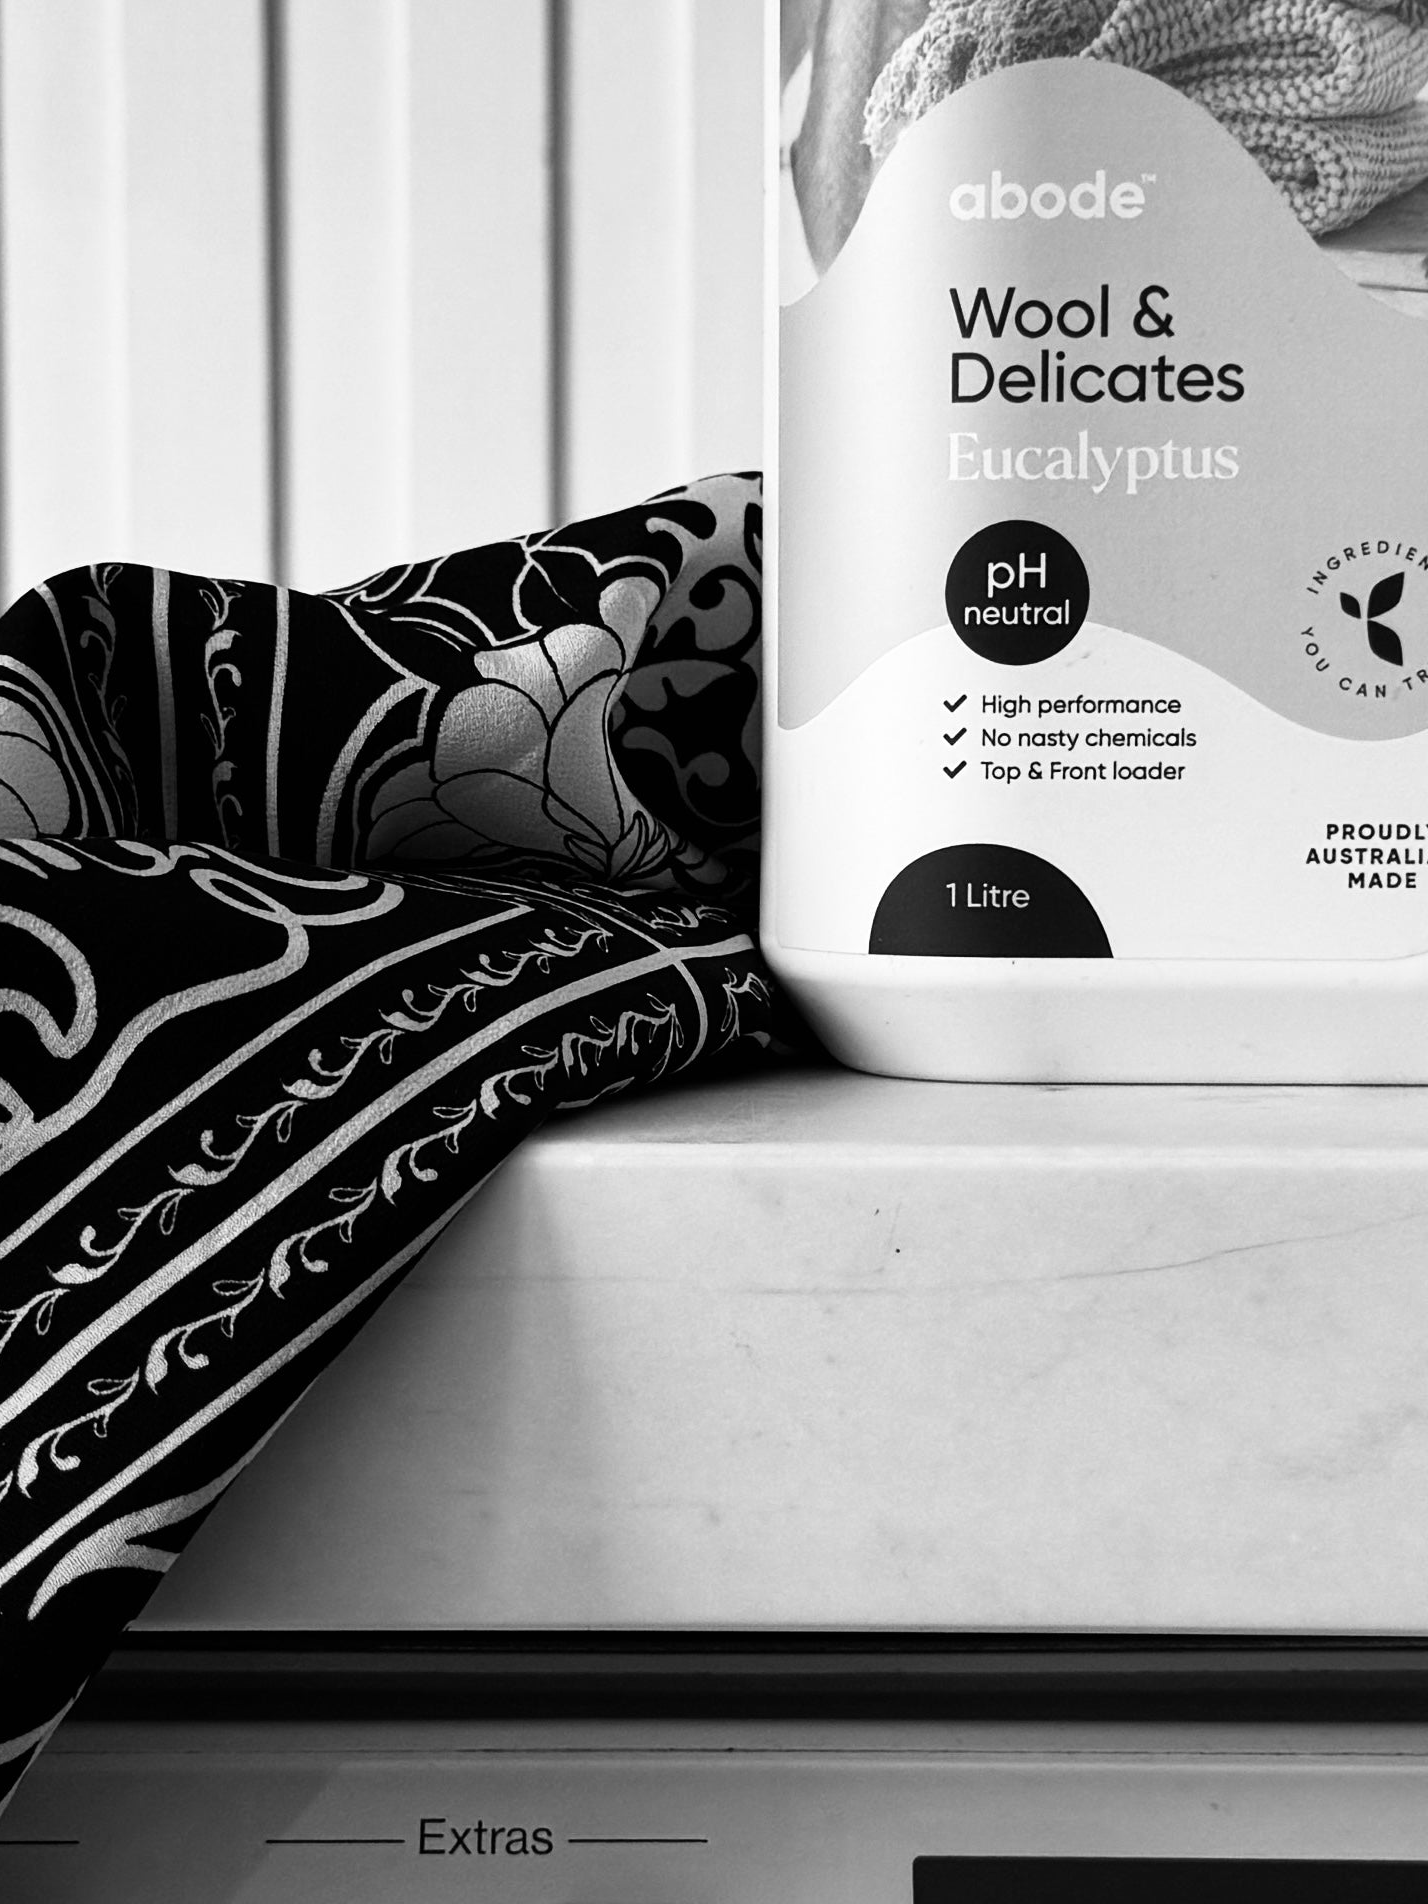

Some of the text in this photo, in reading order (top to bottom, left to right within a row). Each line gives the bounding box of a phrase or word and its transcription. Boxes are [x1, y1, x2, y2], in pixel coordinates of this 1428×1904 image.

[949, 283, 1175, 339] Wool &
[951, 348, 1245, 404] Delicates
[948, 429, 1241, 494] Eucalyptus
[987, 552, 1046, 598] pH
[964, 598, 1070, 626] neutral
[1301, 626, 1330, 673] YOU
[1338, 676, 1387, 699] CAN
[982, 694, 1182, 719] High performance
[982, 727, 1197, 752] No nasty chemicals
[980, 760, 1186, 785] Top & Front loader
[946, 882, 1030, 908] 1 Litre
[1348, 872, 1417, 889] MADE
[418, 1817, 554, 1856] Extras
